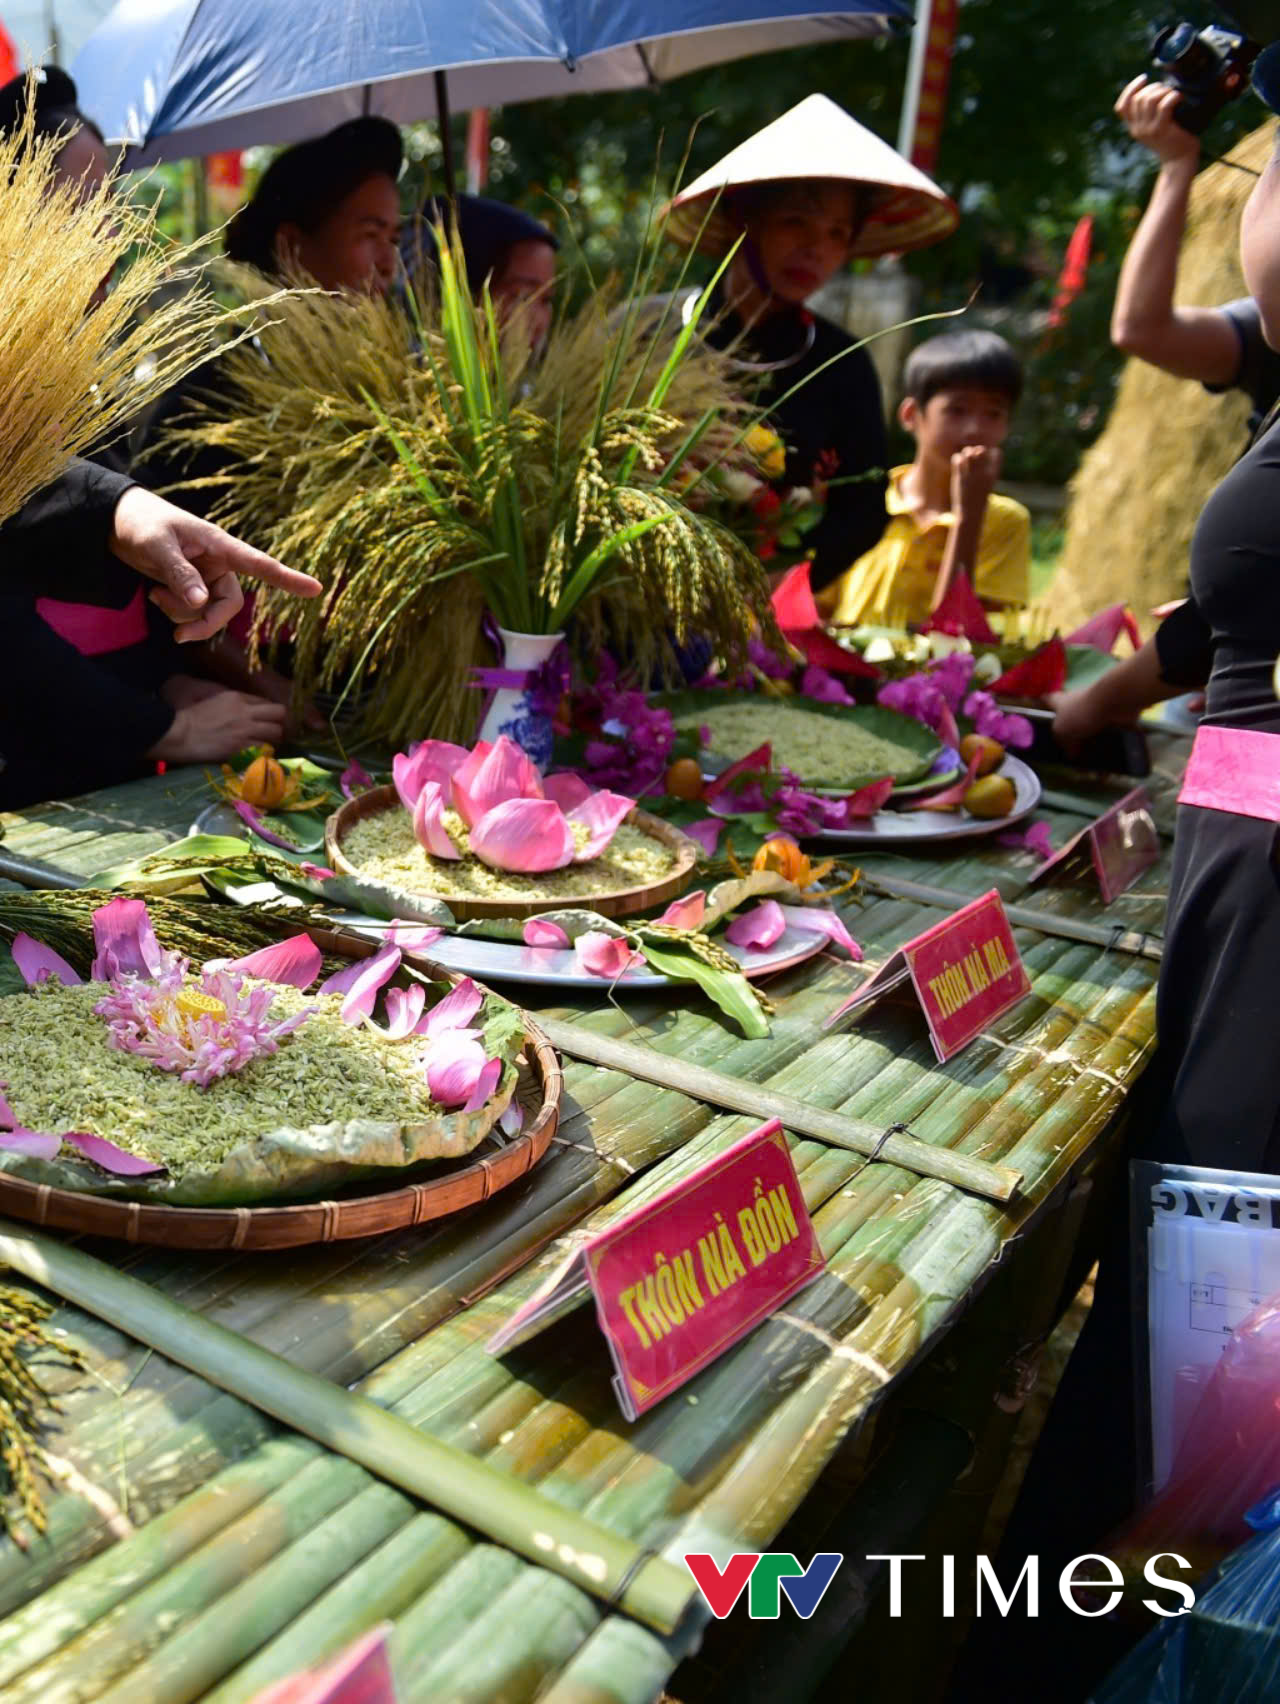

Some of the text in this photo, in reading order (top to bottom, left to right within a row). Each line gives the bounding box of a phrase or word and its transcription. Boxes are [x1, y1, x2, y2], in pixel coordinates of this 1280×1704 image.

[618, 1177, 799, 1350] THÔN NÀ ĐỒN
